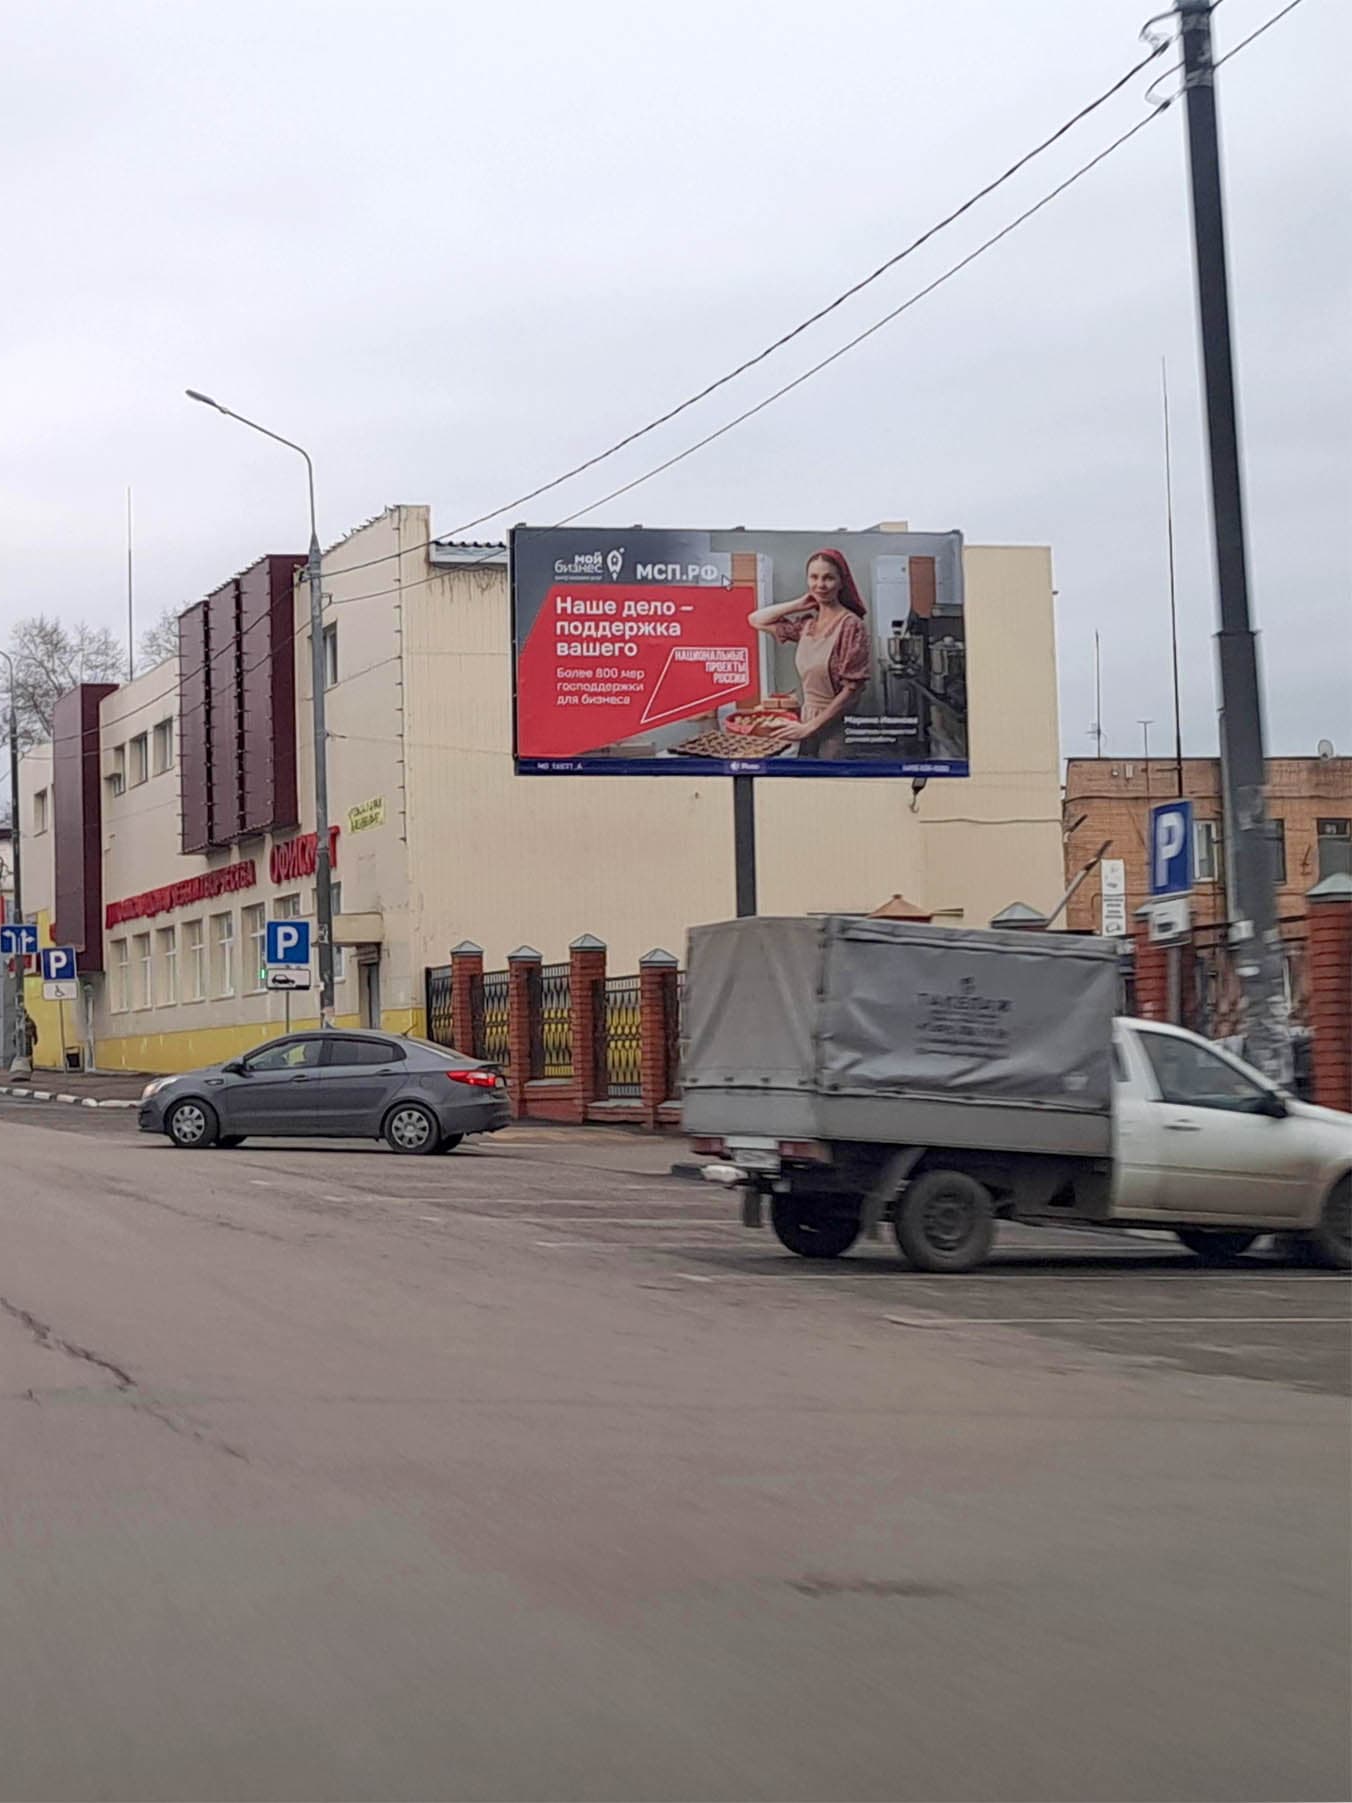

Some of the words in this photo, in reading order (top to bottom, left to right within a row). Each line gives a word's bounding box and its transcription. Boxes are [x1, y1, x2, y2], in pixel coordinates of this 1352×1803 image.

[574, 552, 602, 564] мой
[554, 560, 603, 574] бизнес
[636, 563, 718, 581] МСП.РФ
[556, 597, 616, 615] Наше
[622, 601, 676, 617] дело
[556, 621, 681, 639] поддержка
[556, 641, 638, 657] вашего
[675, 650, 745, 661] НАЦИОНАЛЬНЫЕ
[556, 667, 593, 678] Более
[595, 667, 618, 678] 800
[620, 669, 645, 680] мер
[705, 662, 746, 673] ПРОЕКТЫ
[556, 682, 644, 693] господдержки
[556, 695, 579, 705] для
[581, 694, 631, 704] бизнеса
[277, 926, 299, 959] P
[50, 950, 67, 978] P
